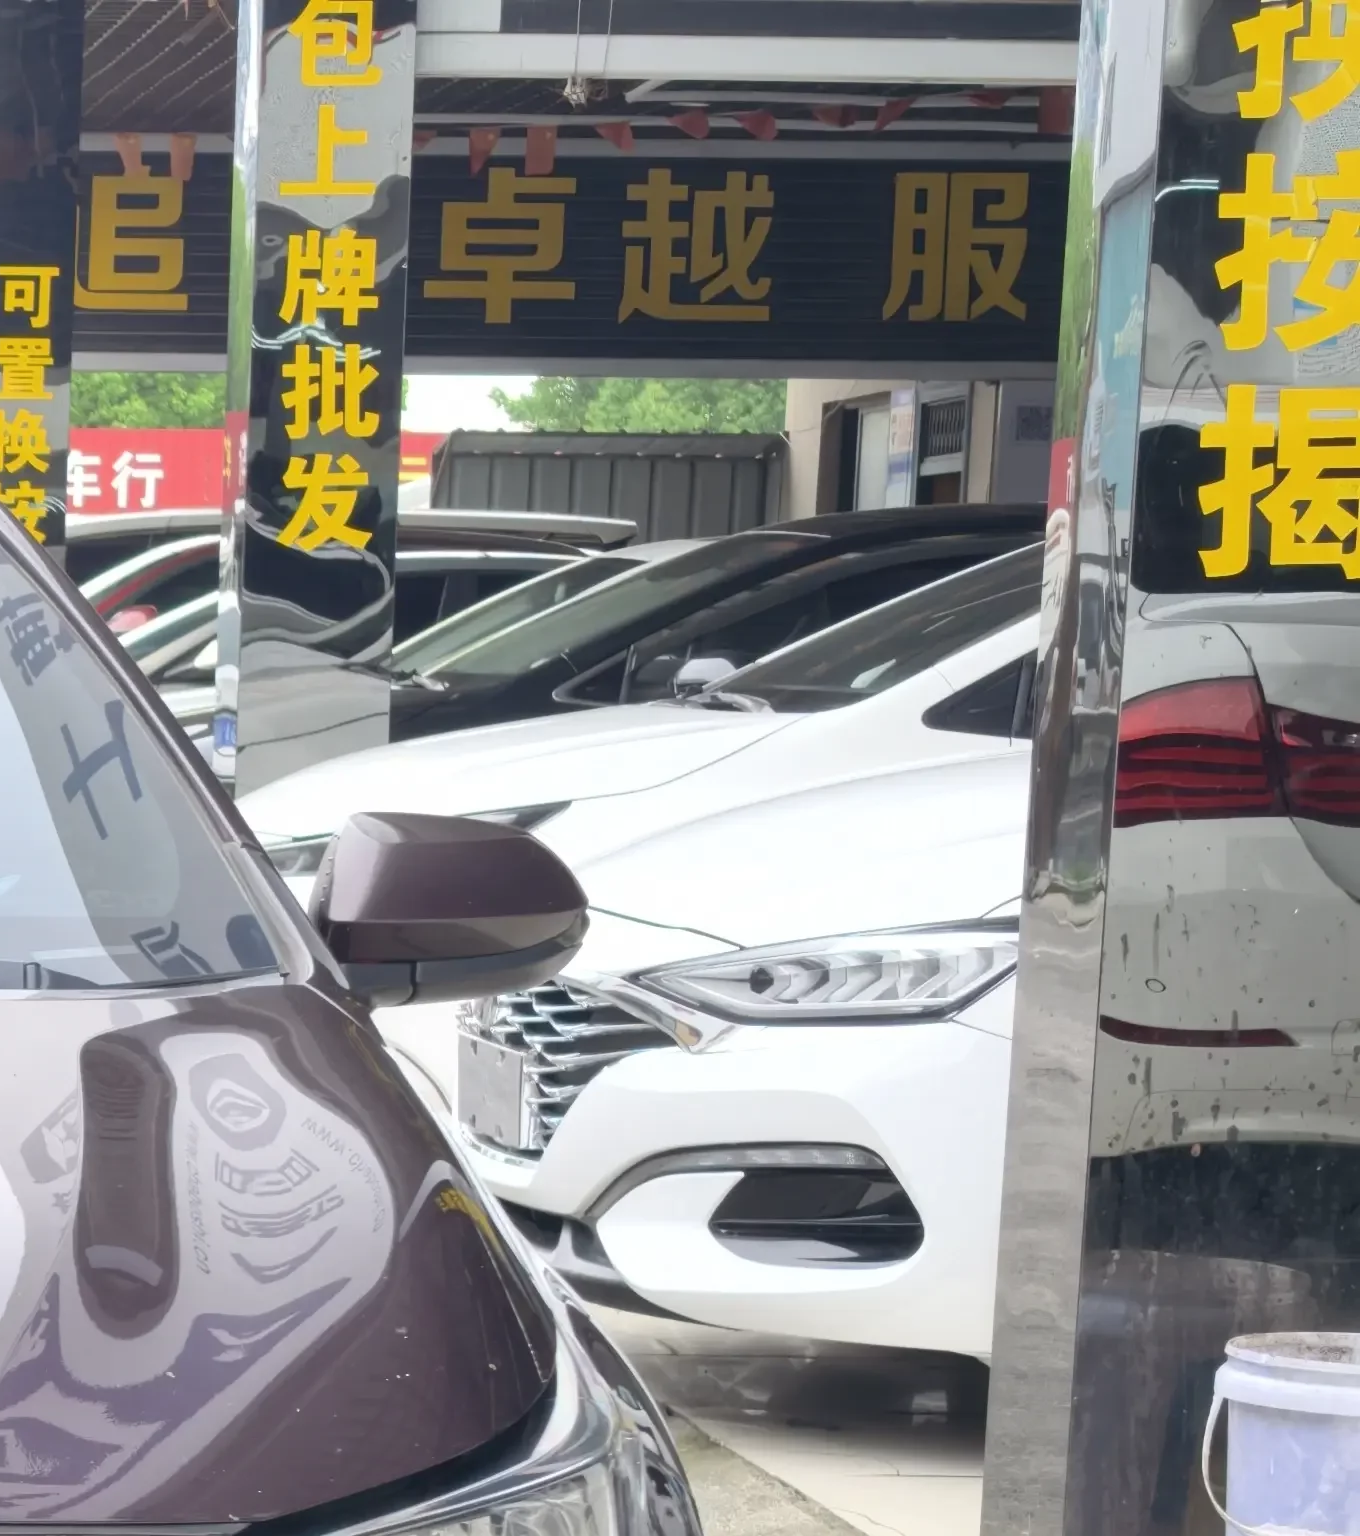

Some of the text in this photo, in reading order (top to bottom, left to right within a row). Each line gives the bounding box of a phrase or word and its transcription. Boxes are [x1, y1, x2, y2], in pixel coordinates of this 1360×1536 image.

[277, 0, 383, 553] 包上牌批发
